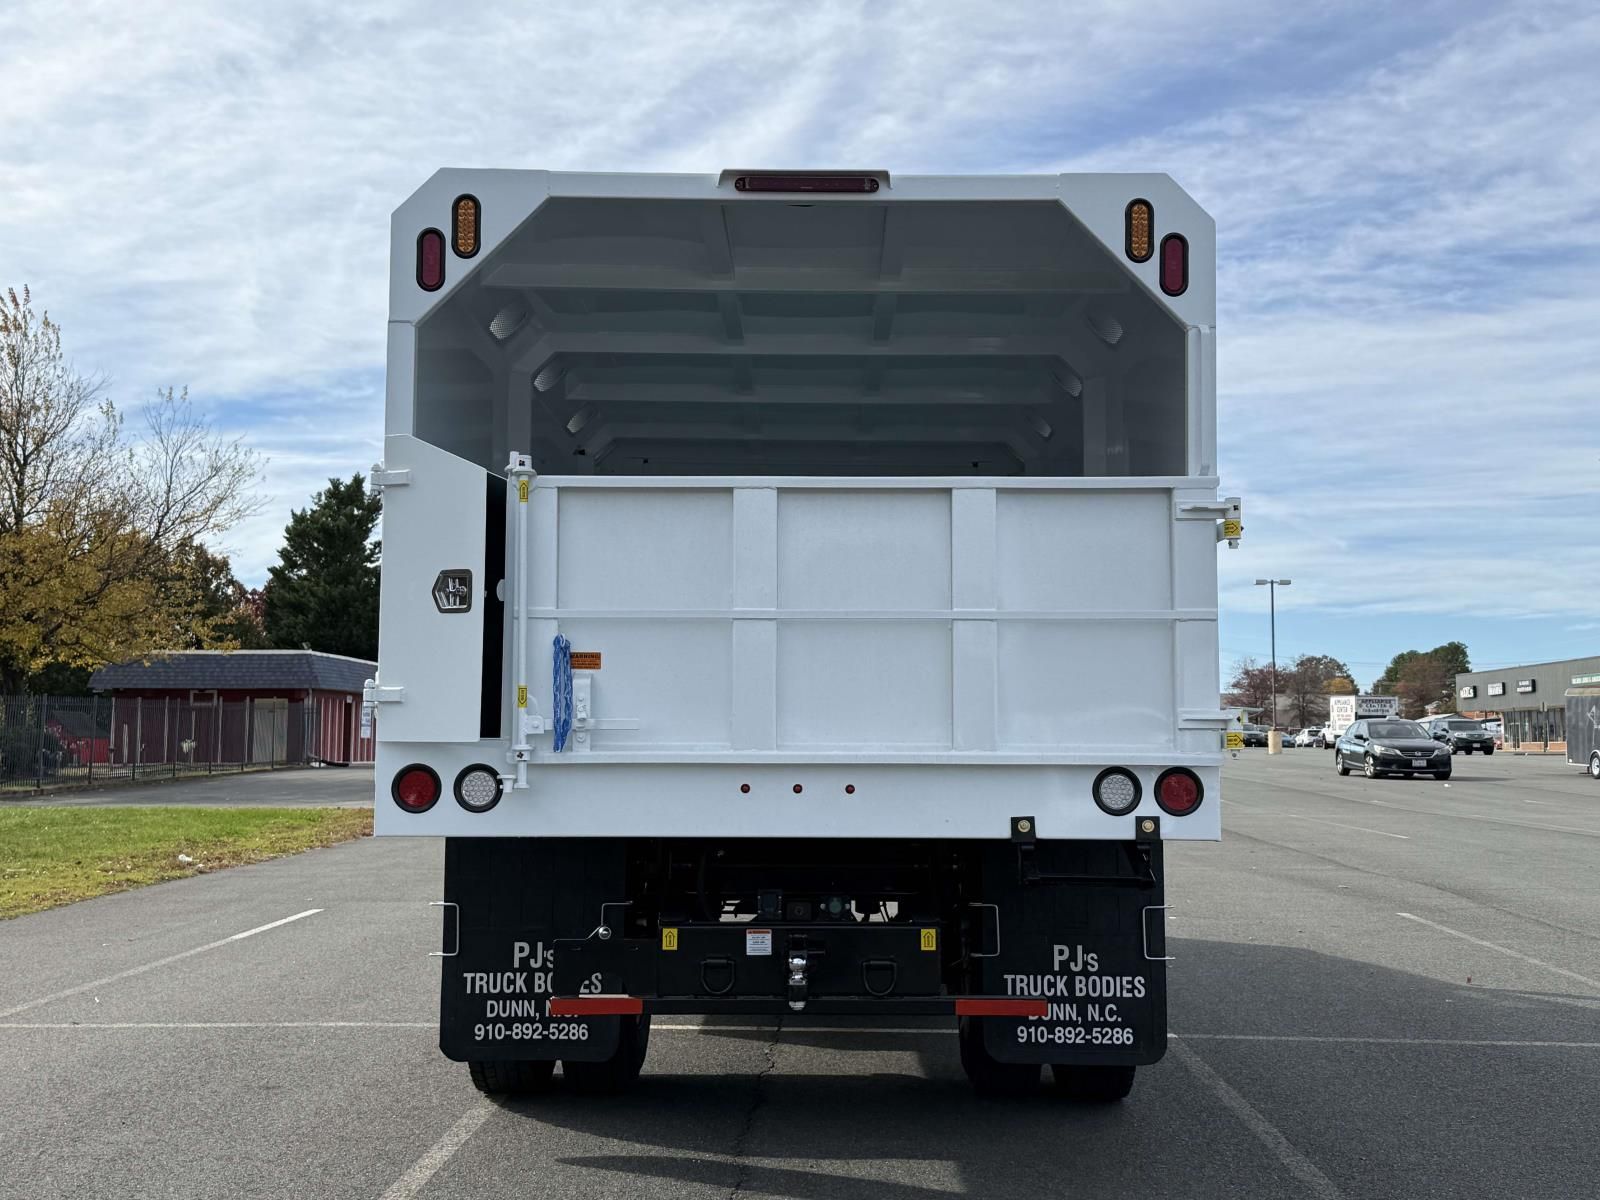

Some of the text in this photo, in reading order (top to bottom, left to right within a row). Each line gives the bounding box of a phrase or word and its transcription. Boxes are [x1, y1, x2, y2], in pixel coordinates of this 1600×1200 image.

[463, 972, 528, 994] TRUCK
[1003, 974, 1146, 998] TRUCK BODIES
[486, 1000, 540, 1021] DUNN,
[1028, 1003, 1122, 1024] UNN, N.C.
[474, 1023, 589, 1041] 910-892-5286
[1016, 1026, 1134, 1045] 910-892-5286
